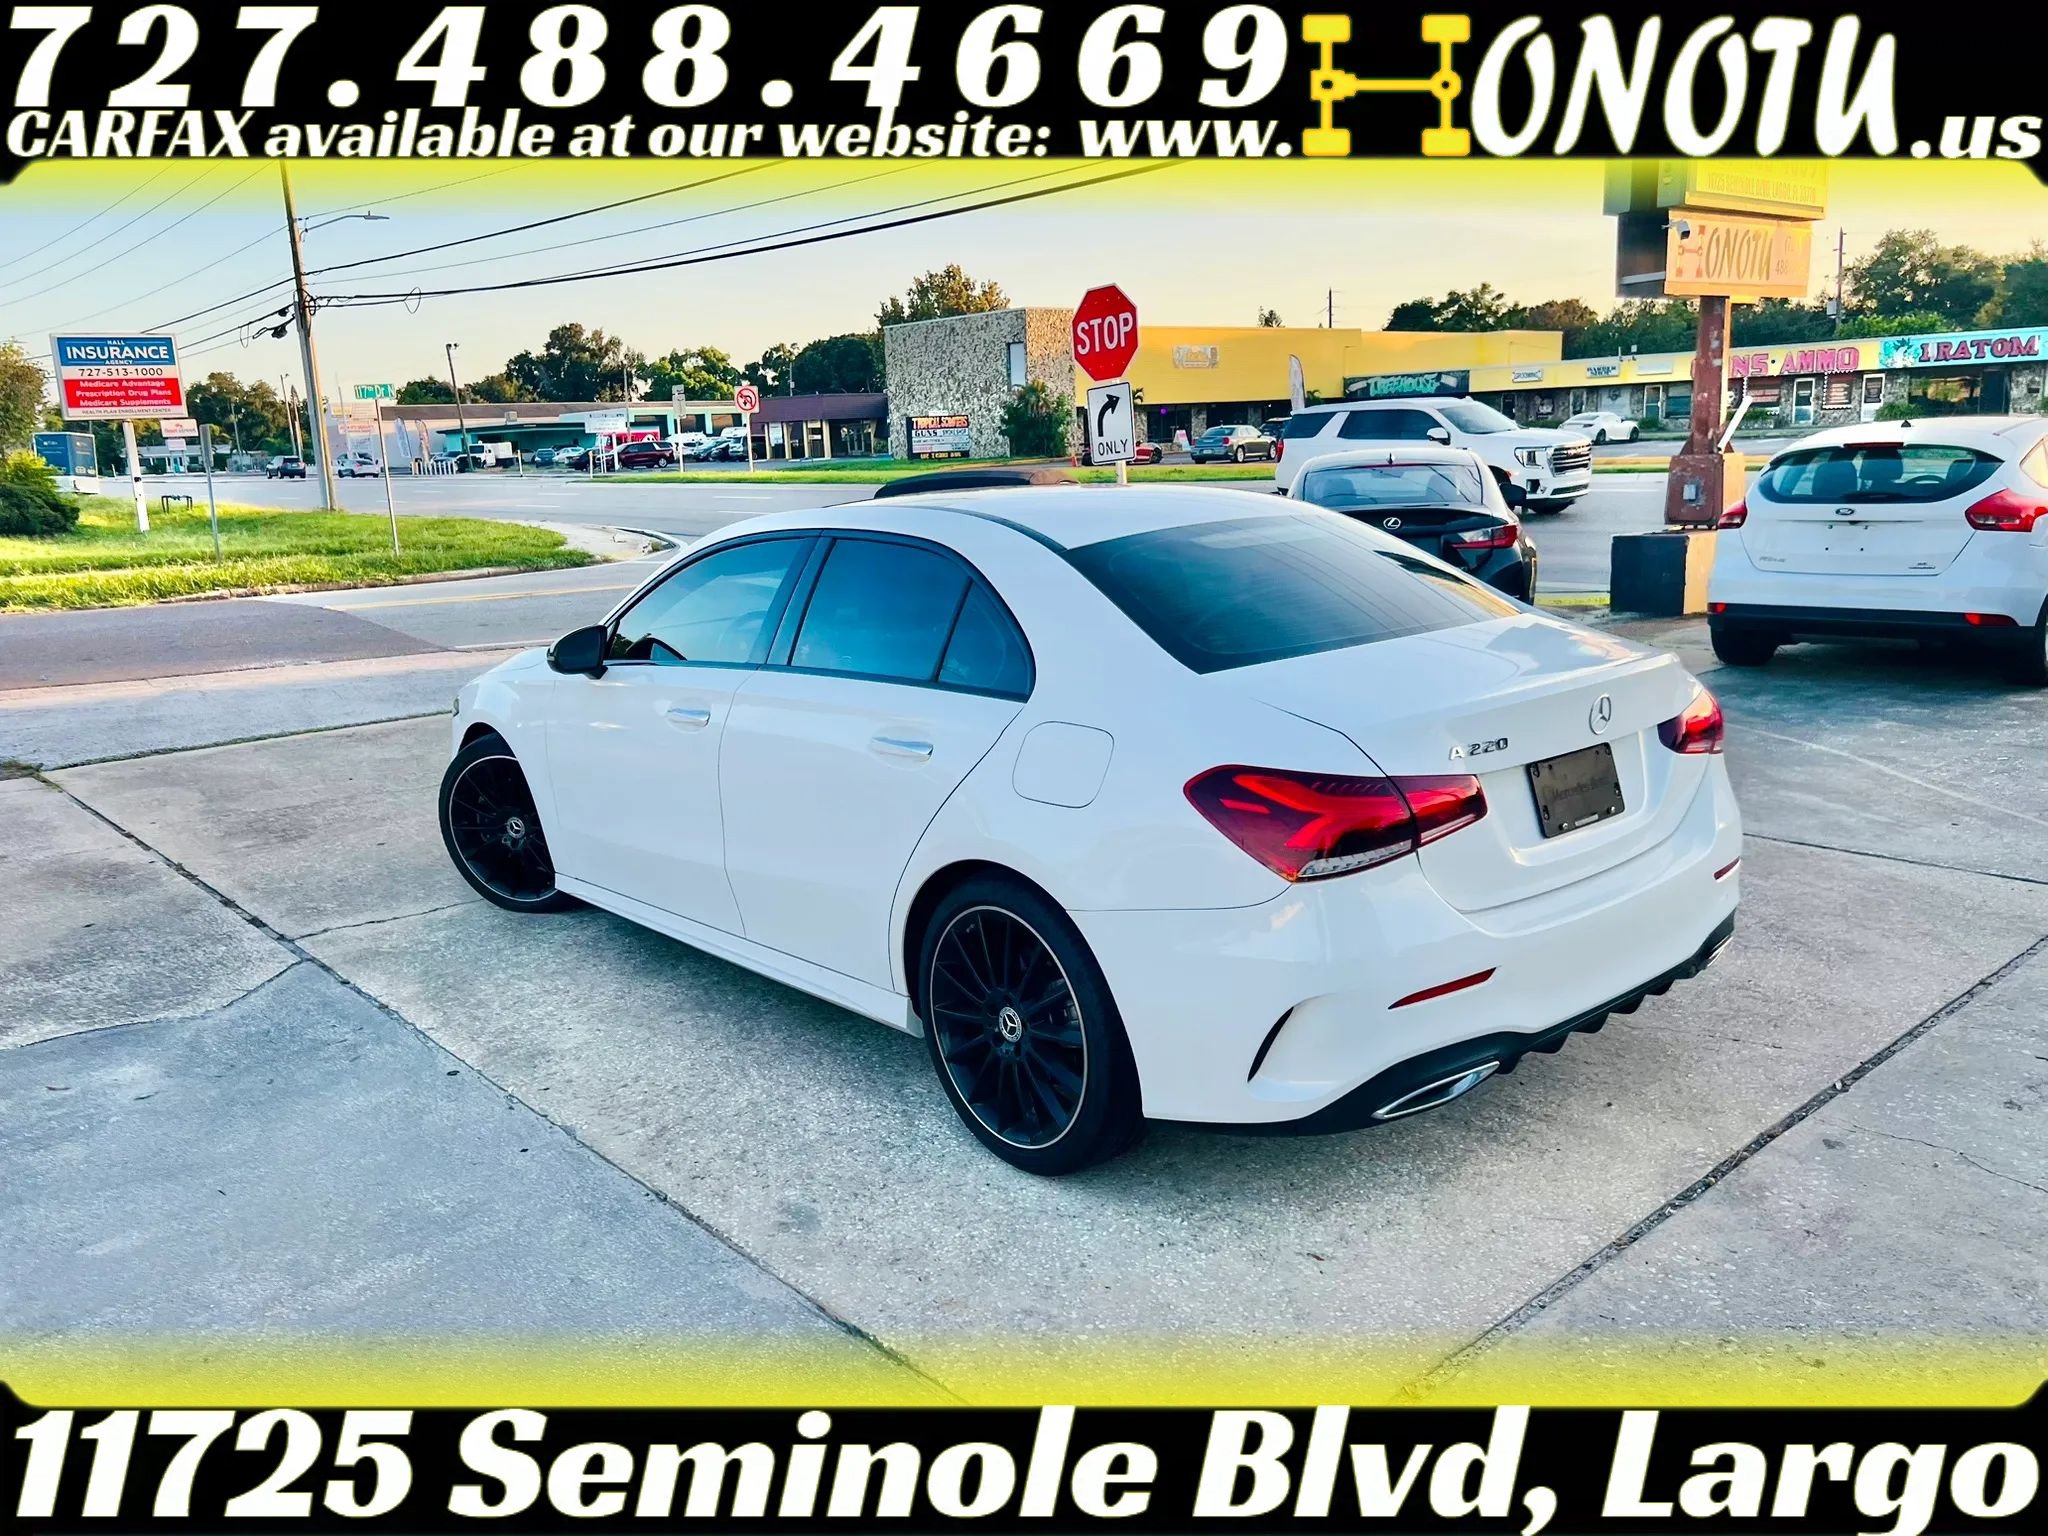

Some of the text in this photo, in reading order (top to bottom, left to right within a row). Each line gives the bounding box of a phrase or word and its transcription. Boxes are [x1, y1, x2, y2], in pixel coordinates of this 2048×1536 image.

[1076, 312, 1134, 355] STOP
[66, 346, 170, 360] INSURANCE
[1731, 347, 1860, 378] NS AMMO
[78, 368, 163, 377] 727-513-1000
[375, 384, 384, 398] Dr
[387, 384, 395, 398] N
[80, 398, 172, 407] Medicare Supplements
[1098, 439, 1128, 457] ONLY
[1449, 737, 1509, 760] A 220
